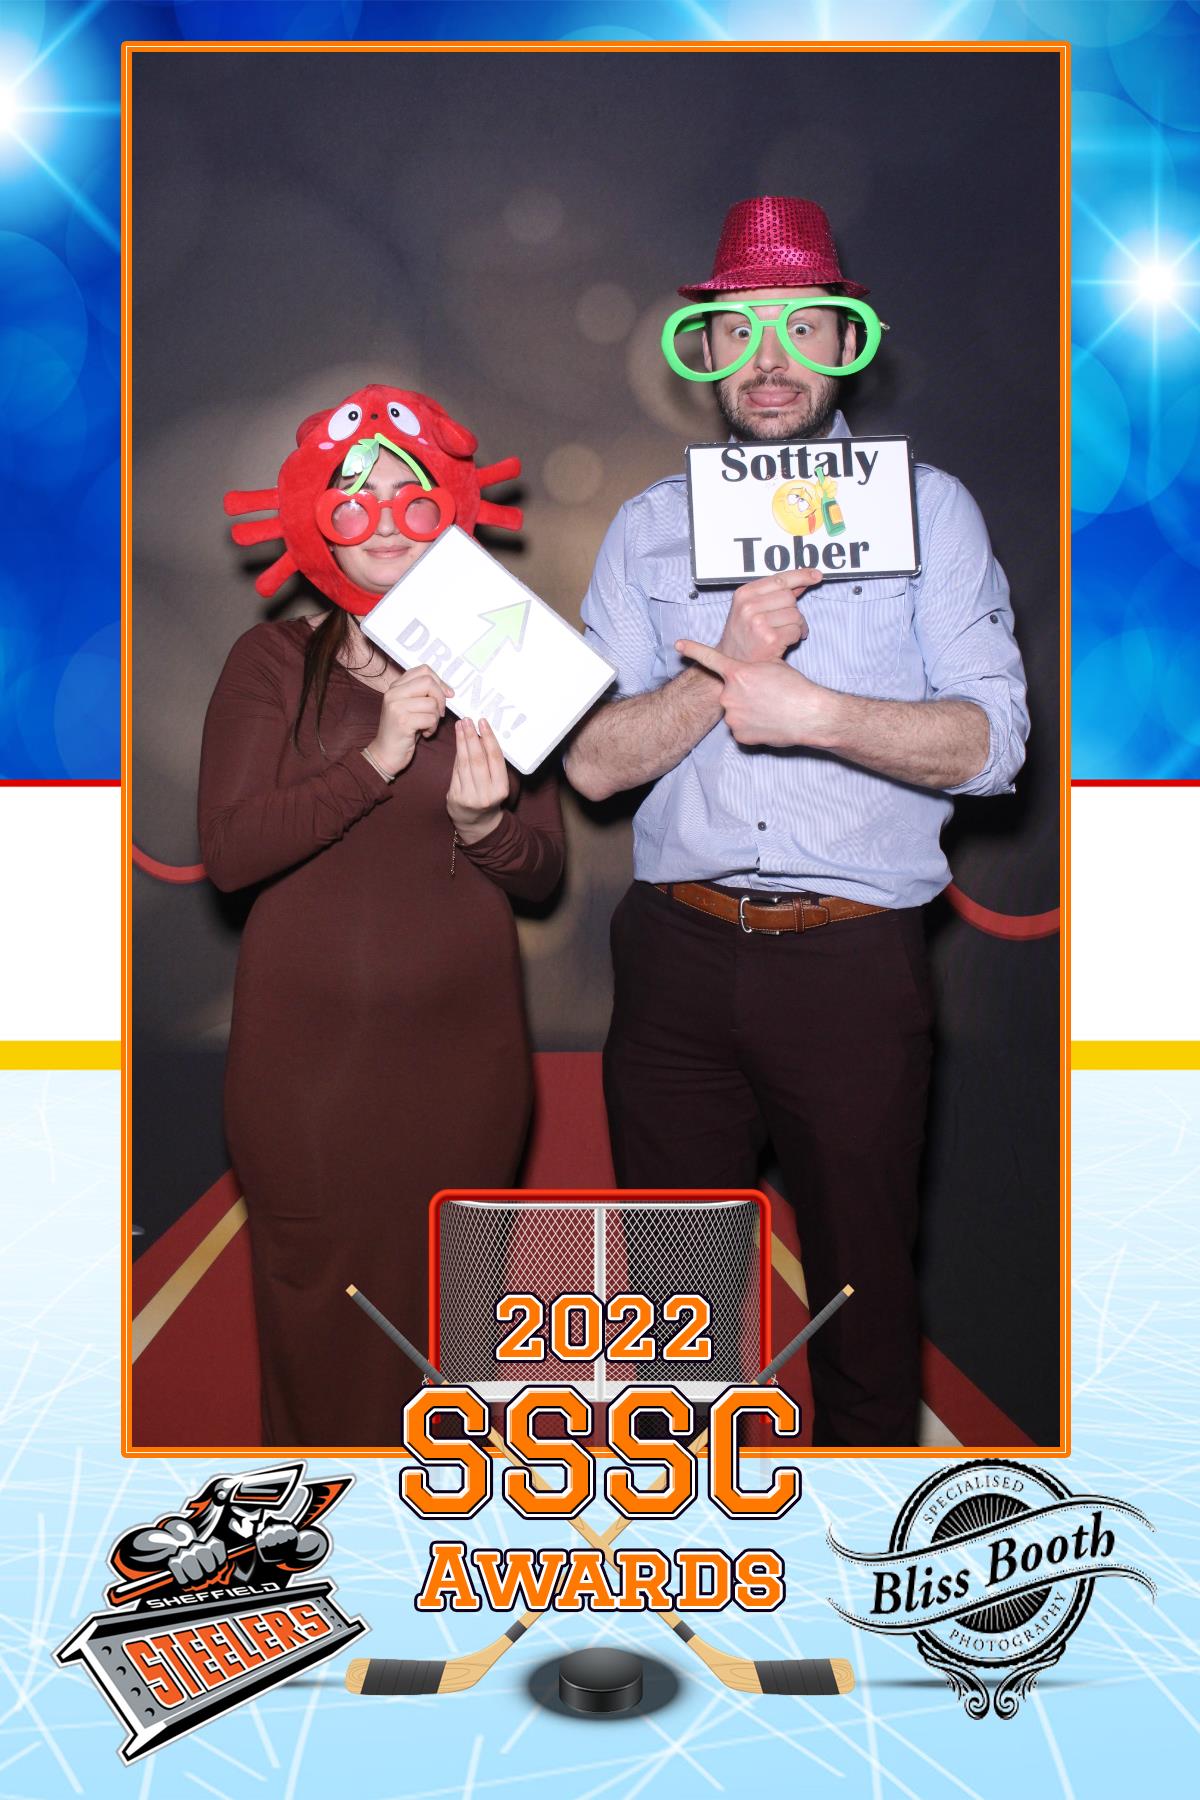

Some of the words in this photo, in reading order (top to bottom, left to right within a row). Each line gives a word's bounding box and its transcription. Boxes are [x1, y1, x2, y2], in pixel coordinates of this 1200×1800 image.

[721, 440, 879, 485] Sottaly
[733, 535, 870, 573] Tober
[395, 616, 528, 740] DRUNK!
